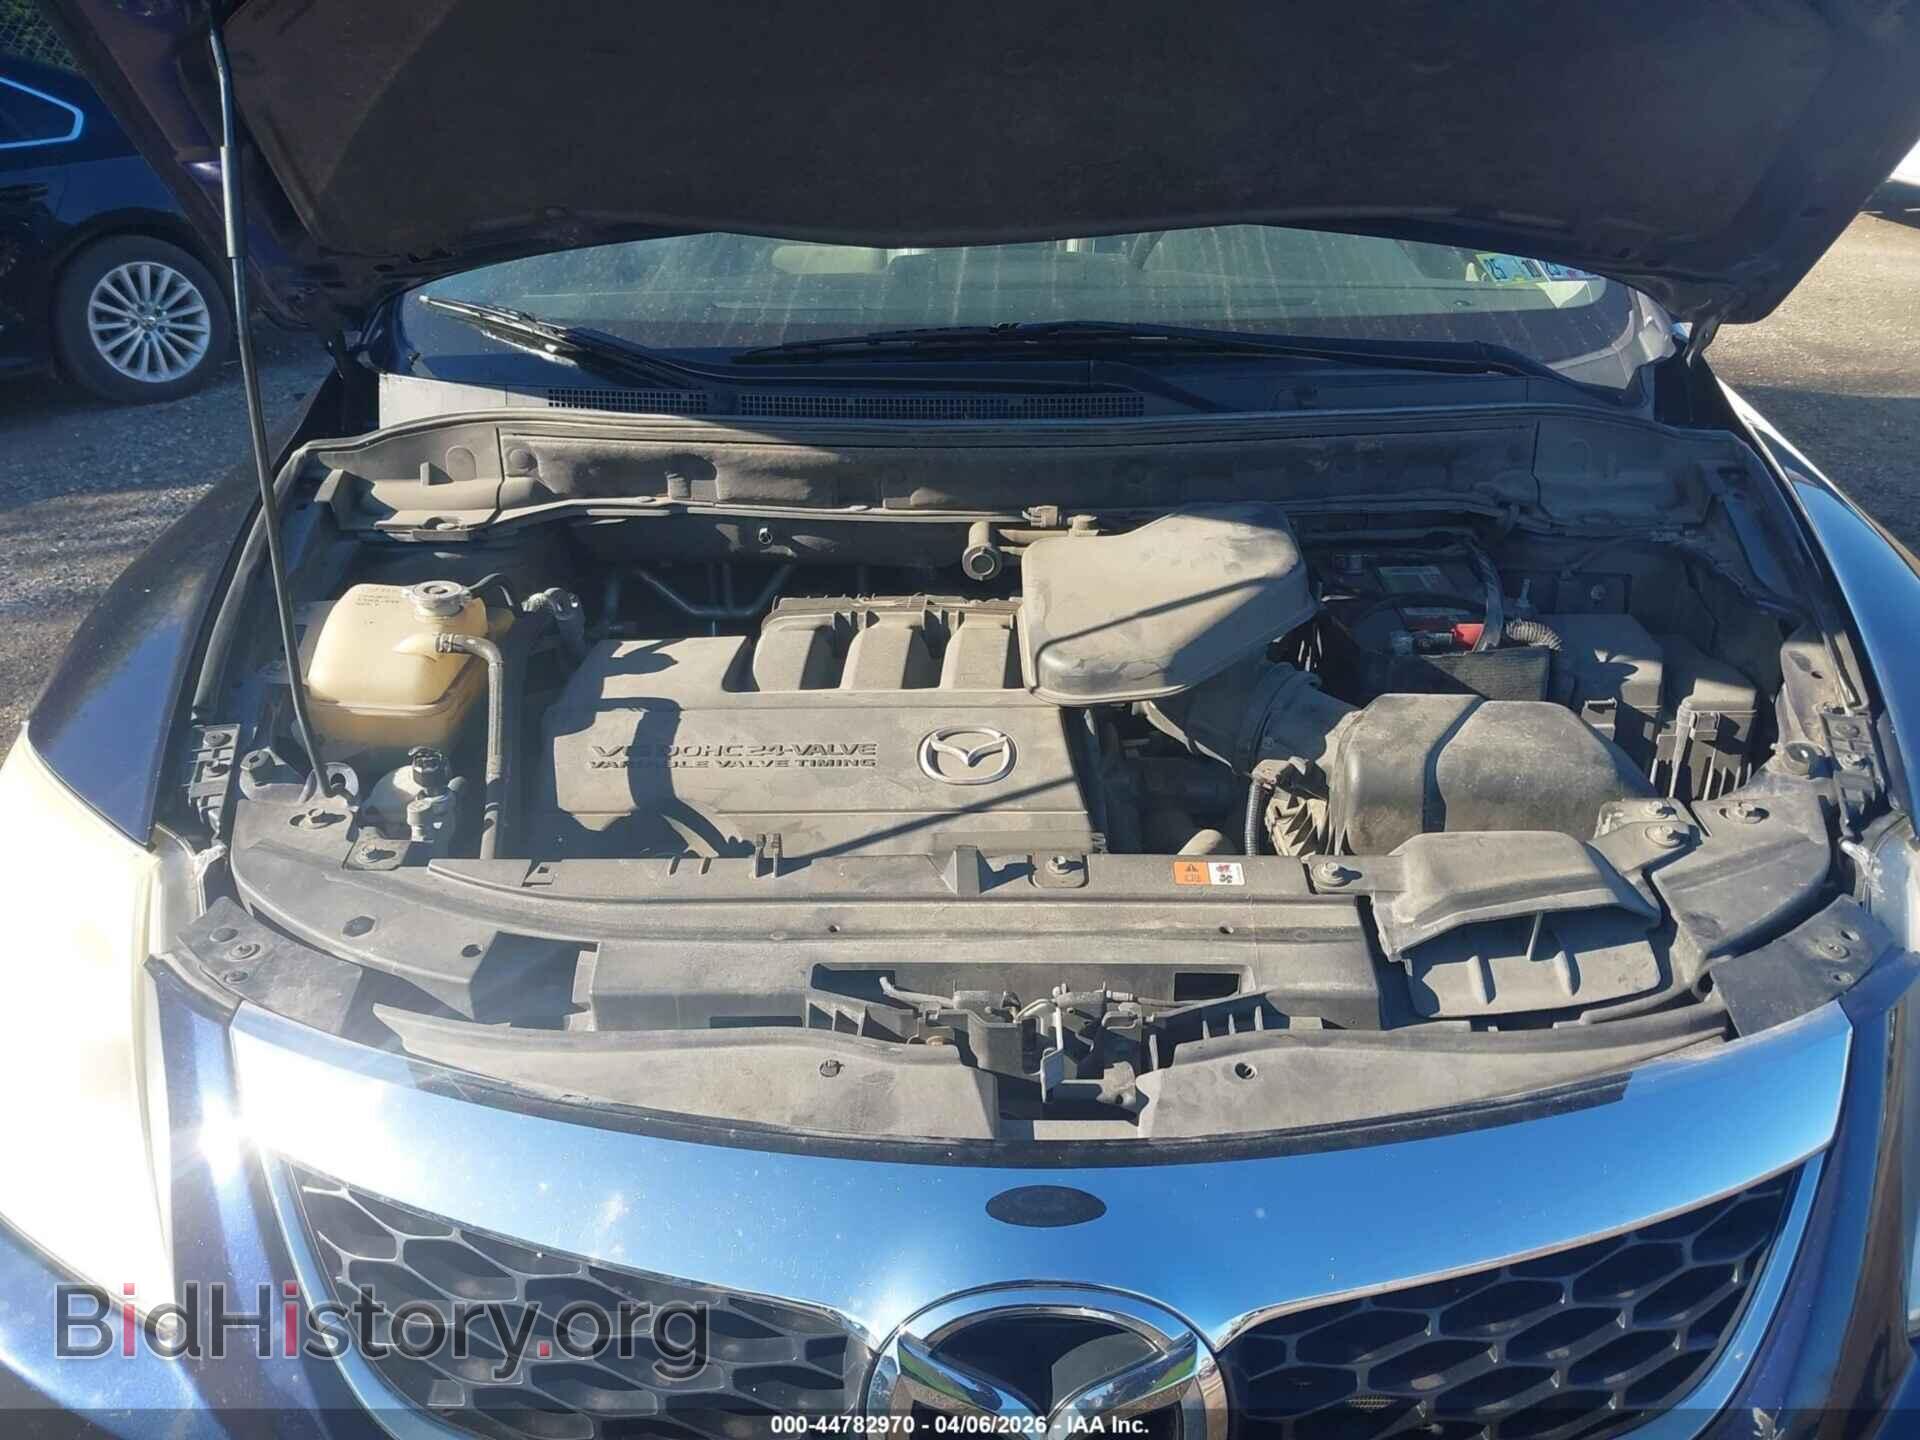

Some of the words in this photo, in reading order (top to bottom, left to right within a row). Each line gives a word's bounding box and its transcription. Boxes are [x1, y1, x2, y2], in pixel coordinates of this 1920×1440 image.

[749, 743, 878, 757] 24-VALVE
[589, 759, 709, 769] VARLE
[717, 759, 791, 769] VALVE
[797, 758, 877, 768] TIMING
